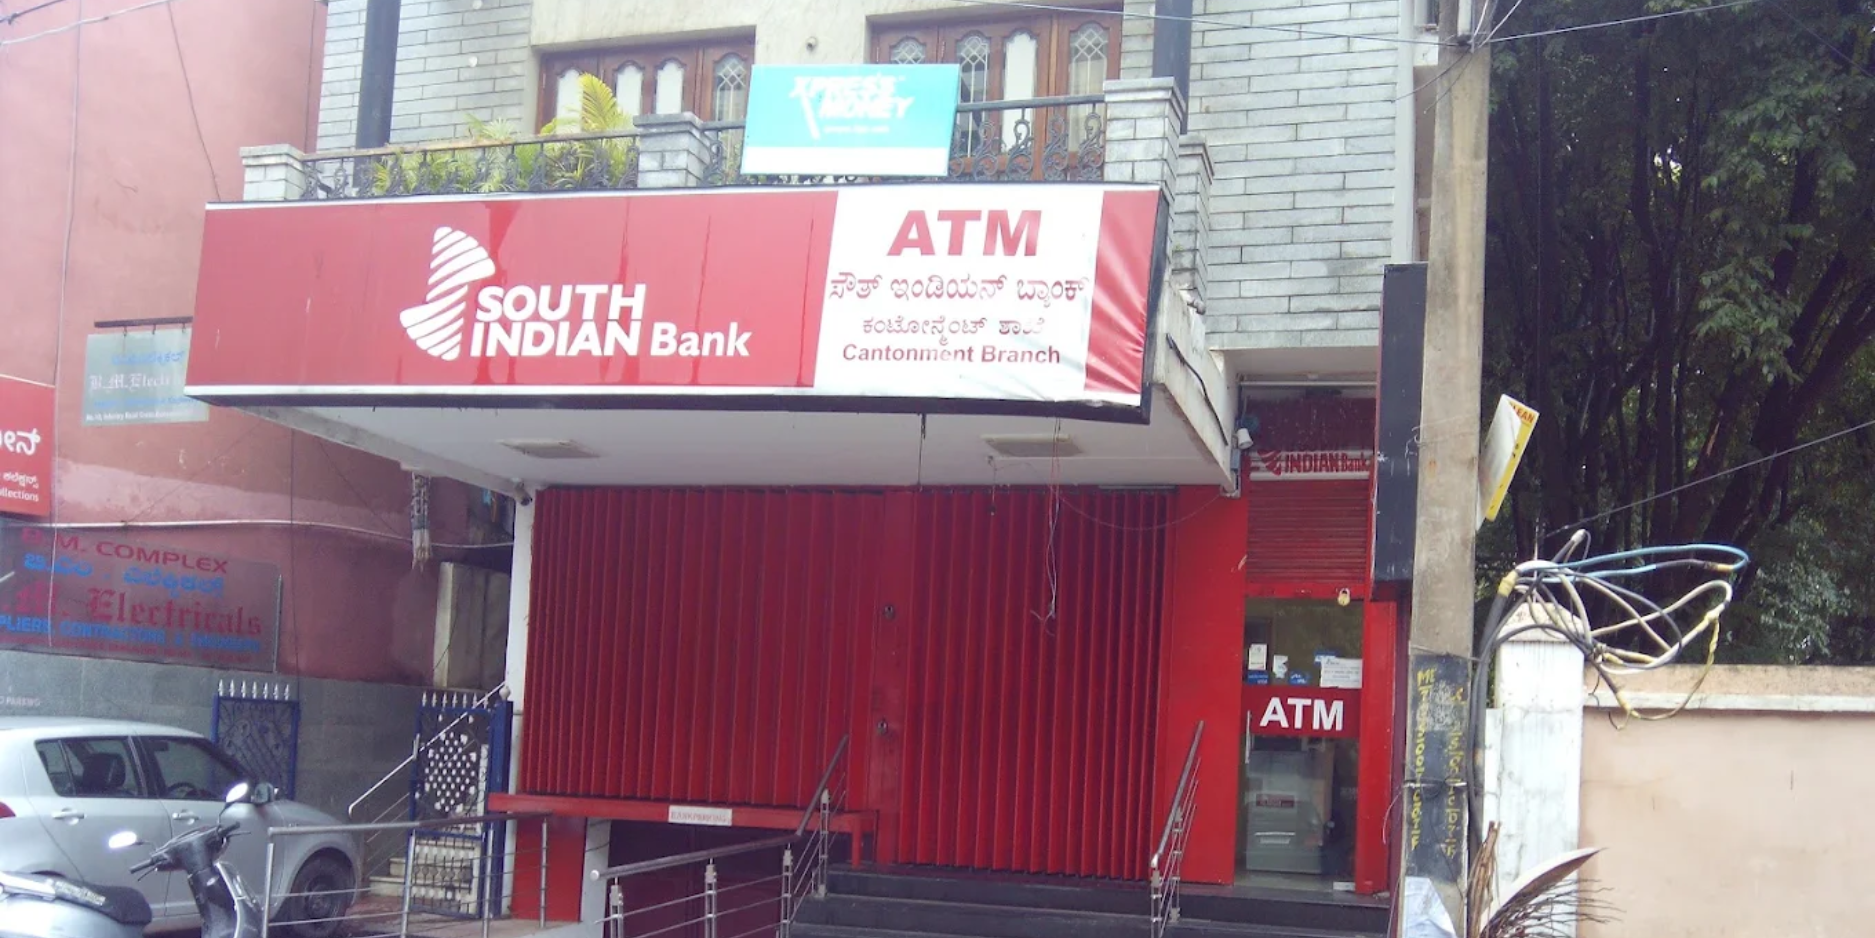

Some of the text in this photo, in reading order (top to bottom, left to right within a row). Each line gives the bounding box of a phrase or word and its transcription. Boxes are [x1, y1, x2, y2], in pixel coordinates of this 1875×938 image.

[819, 97, 915, 119] MONEY
[887, 210, 1042, 257] ATM
[475, 284, 646, 322] SOUTH
[829, 272, 883, 301] ಸೌತ್
[890, 274, 1007, 301] ಇಂಡಿಯನ್
[470, 320, 752, 357] INDIAN Bank
[843, 344, 1061, 364] Cantonment Branch
[1285, 452, 1338, 473] INDIAN
[96, 541, 228, 575] COMPLEX
[88, 588, 262, 636] Electricals
[1259, 697, 1343, 731] ATM
